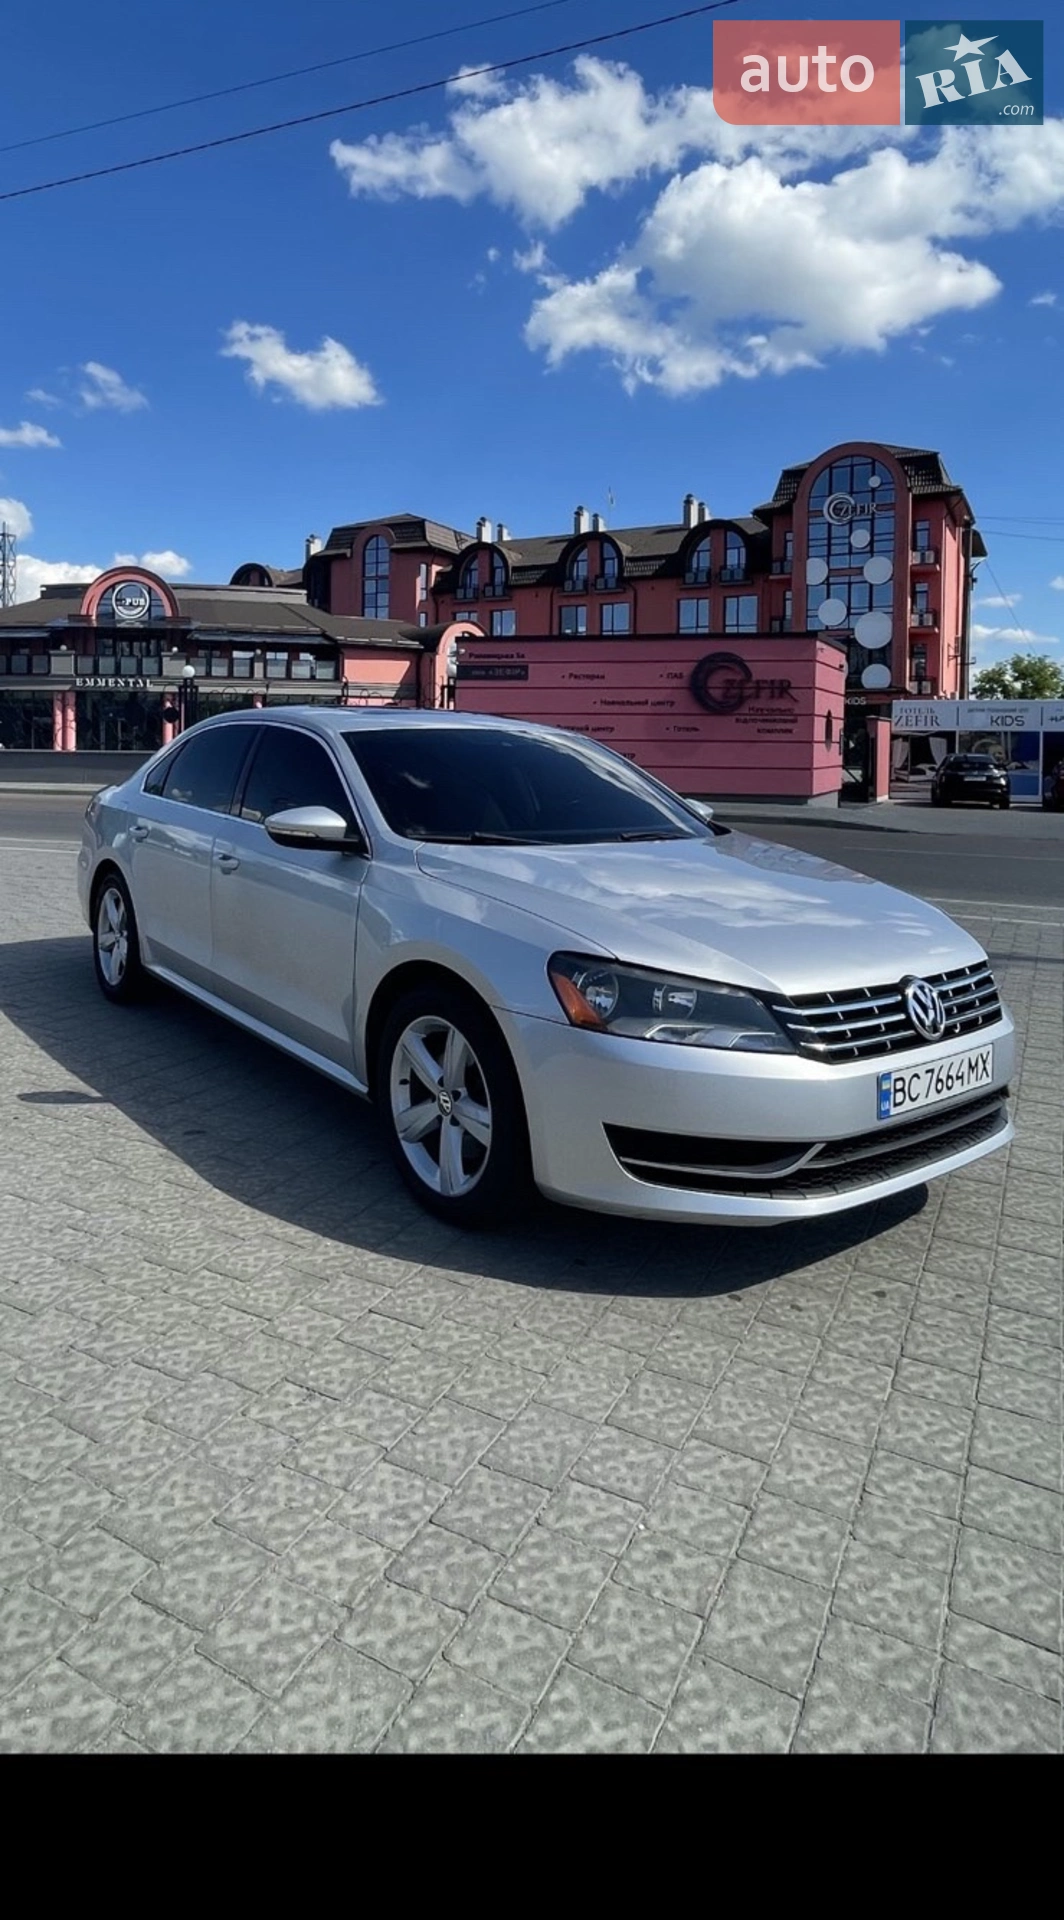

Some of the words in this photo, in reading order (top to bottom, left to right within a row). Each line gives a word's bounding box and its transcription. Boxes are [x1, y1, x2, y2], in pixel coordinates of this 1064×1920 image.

[839, 502, 882, 516] ZEFIR
[125, 597, 146, 606] PUB
[75, 677, 154, 689] EMMENTAL
[722, 678, 800, 703] ZEFIR
[894, 714, 941, 727] ZEFIR
[989, 715, 1025, 727] KIDS
